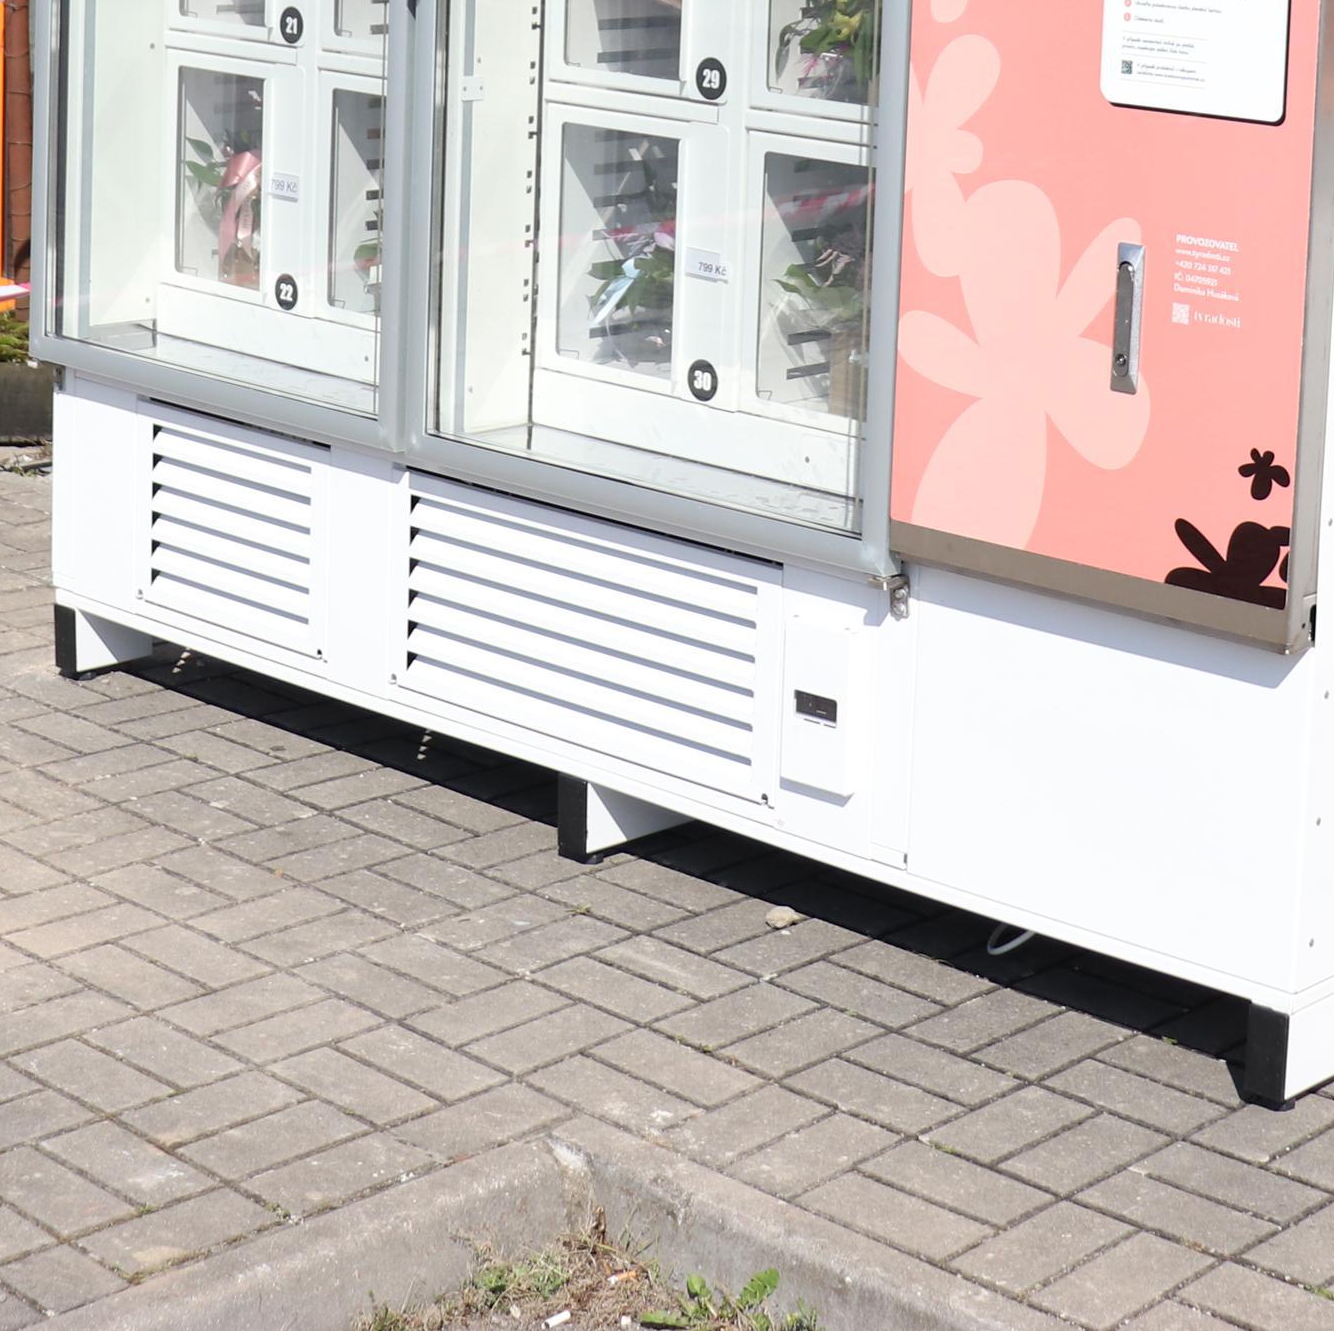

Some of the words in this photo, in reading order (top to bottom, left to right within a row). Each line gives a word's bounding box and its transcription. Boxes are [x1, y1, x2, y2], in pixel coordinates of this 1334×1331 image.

[285, 16, 298, 35] 21
[702, 68, 721, 90] 29
[1175, 233, 1239, 252] PROVOZOVATEL
[698, 261, 713, 273] 799
[279, 282, 294, 302] 22
[693, 370, 712, 392] 30
